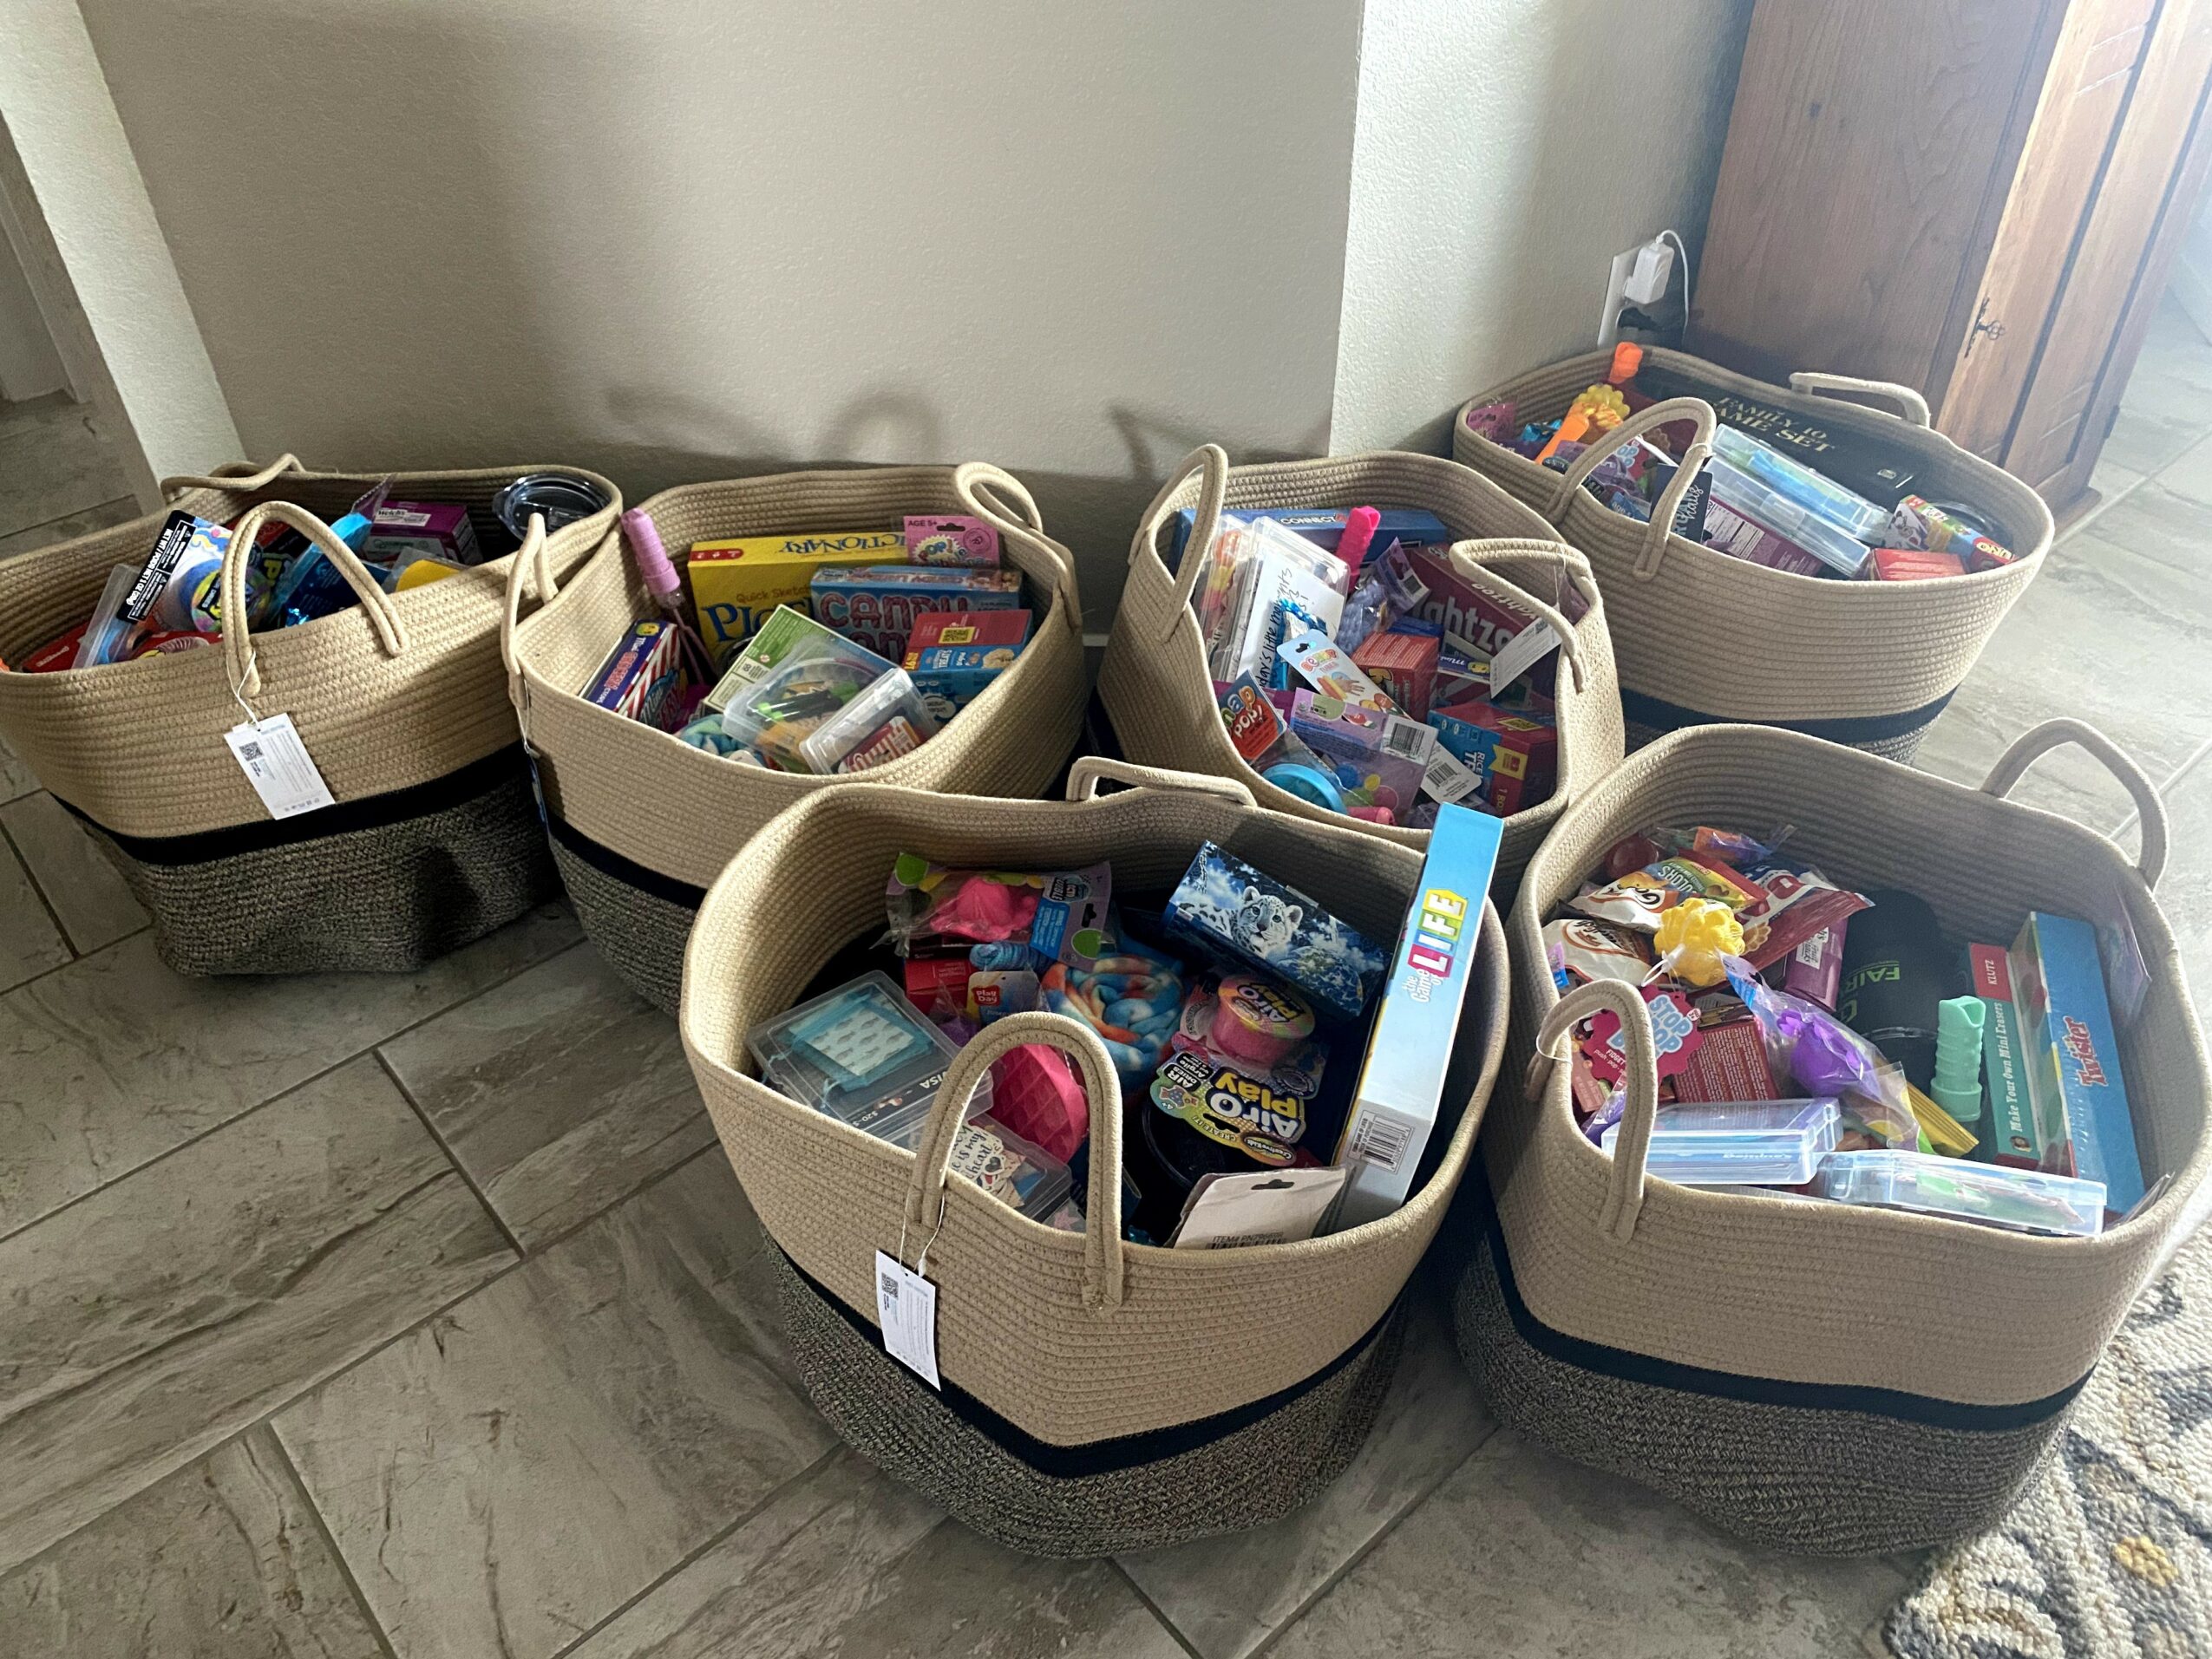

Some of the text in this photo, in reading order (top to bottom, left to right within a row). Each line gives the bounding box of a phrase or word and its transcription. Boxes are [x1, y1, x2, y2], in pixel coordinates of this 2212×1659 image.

[1715, 397, 1796, 428] FAMILY
[1720, 408, 1836, 452] AME SET
[781, 532, 905, 554] ICTIONARY
[736, 591, 768, 604] Quick
[1263, 626, 1277, 652] little
[1221, 685, 1256, 729] nap
[1476, 751, 1486, 774] RICE
[1411, 892, 1463, 973] LIFE
[1402, 975, 1418, 991] the
[1410, 967, 1432, 1003] Game
[1987, 959, 1998, 985] KLUTZ
[1238, 985, 1290, 1023] AirO
[1251, 982, 1299, 1019] Play
[1649, 995, 1693, 1037] STOP
[1594, 1049, 1607, 1061] push
[1605, 1049, 1626, 1065] FIDGET
[2062, 1016, 2110, 1088] Twister
[919, 1071, 946, 1089] ISA
[1167, 1069, 1194, 1089] AIR
[1173, 1065, 1197, 1085] DRIES
[1995, 1003, 2024, 1132] Make Your Own Mini Erasers
[1215, 1072, 1297, 1119] Play
[1210, 1091, 1299, 1139] AirO
[1202, 1120, 1236, 1142] CREATE
